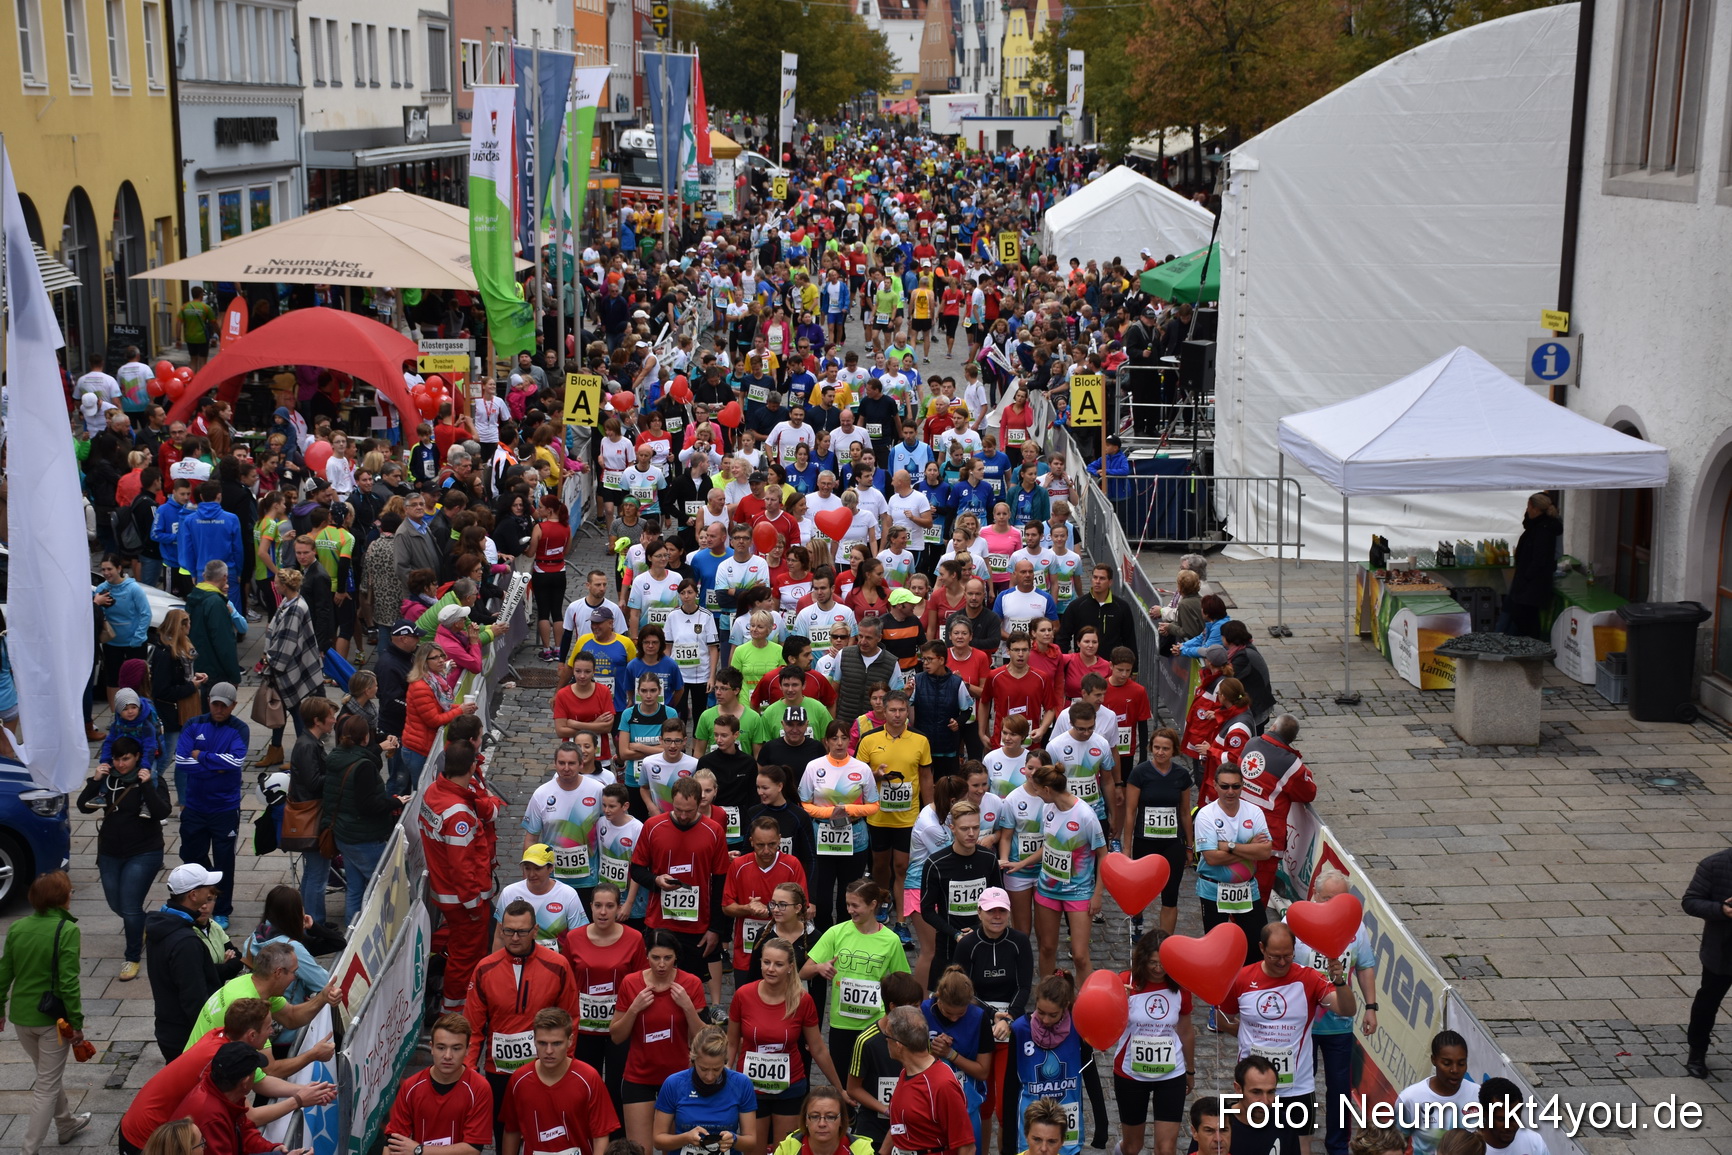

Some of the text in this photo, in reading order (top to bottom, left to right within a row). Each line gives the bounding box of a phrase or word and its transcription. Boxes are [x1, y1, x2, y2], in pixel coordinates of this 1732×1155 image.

[776, 185, 784, 195] C
[1005, 242, 1015, 256] B
[268, 258, 363, 270] Neumarkter
[243, 265, 374, 279] Lammsbräu
[421, 341, 464, 351] Klostergasse
[571, 376, 598, 387] Block
[1074, 377, 1102, 387] Block
[572, 390, 591, 415] A
[1078, 391, 1098, 415] A
[988, 555, 1007, 567] 5076
[676, 648, 698, 659] 5194
[883, 789, 910, 801] 5099
[1070, 783, 1097, 796] 5156
[1148, 815, 1175, 826] 5116
[821, 831, 850, 843] 5072
[556, 853, 586, 867] 5195
[1044, 851, 1068, 871] 5078
[601, 863, 625, 880] 5196
[664, 894, 696, 908] 5129
[953, 887, 984, 902] 5148
[1221, 888, 1249, 902] 5004
[843, 988, 878, 1005] 5074
[582, 1004, 616, 1019] 5094
[848, 1006, 871, 1014] Caterina
[495, 1042, 532, 1060] 5093
[1023, 1041, 1035, 1056] 8
[1135, 1047, 1172, 1062] 5017
[748, 1063, 786, 1080] 5040
[1142, 1065, 1165, 1073] Claudia
